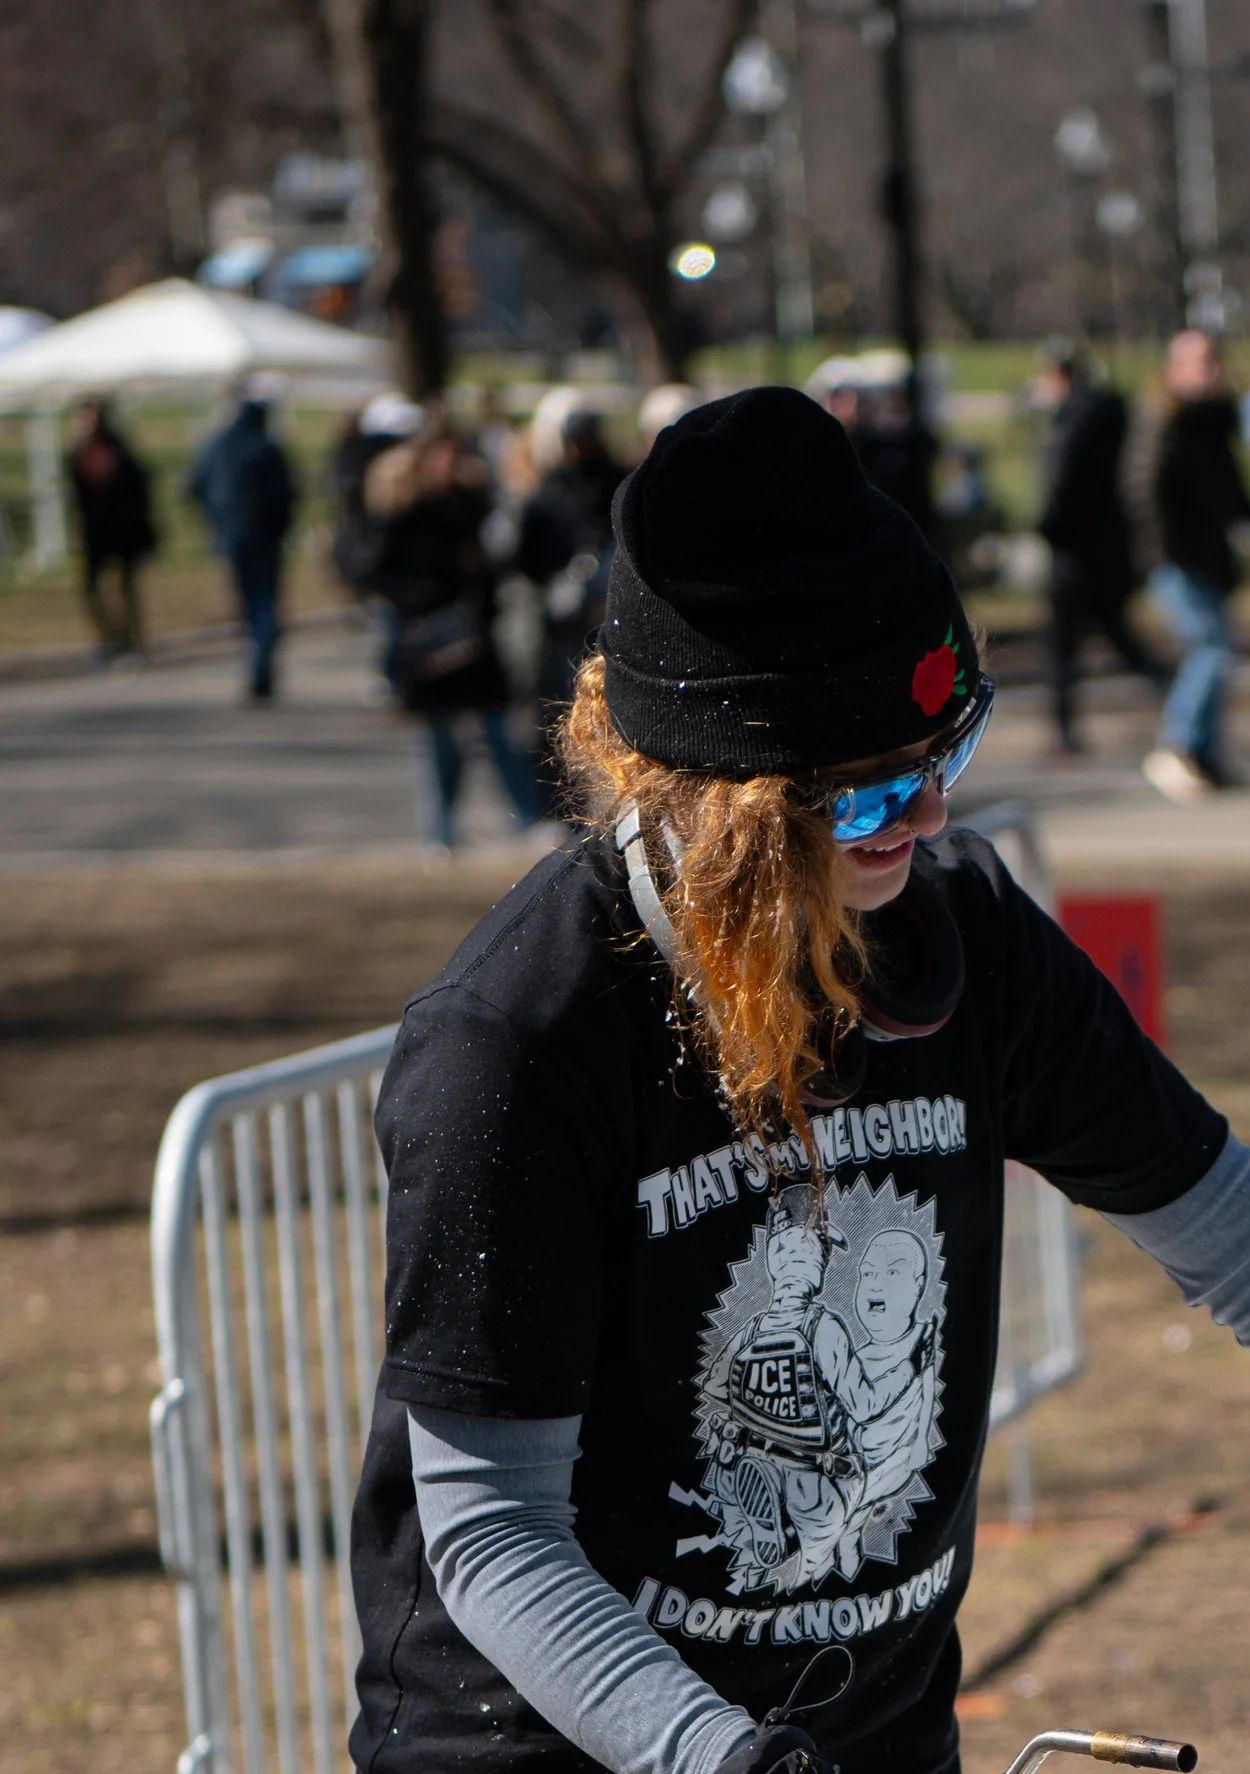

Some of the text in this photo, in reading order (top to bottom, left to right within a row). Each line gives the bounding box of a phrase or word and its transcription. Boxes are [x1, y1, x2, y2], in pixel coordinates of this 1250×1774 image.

[635, 1094, 967, 1239] THAT'S MY NEIGHBOR!
[744, 1387, 797, 1418] POLICE
[747, 1358, 793, 1394] ICE
[631, 1545, 956, 1645] I DON'T KNOW YOU!
